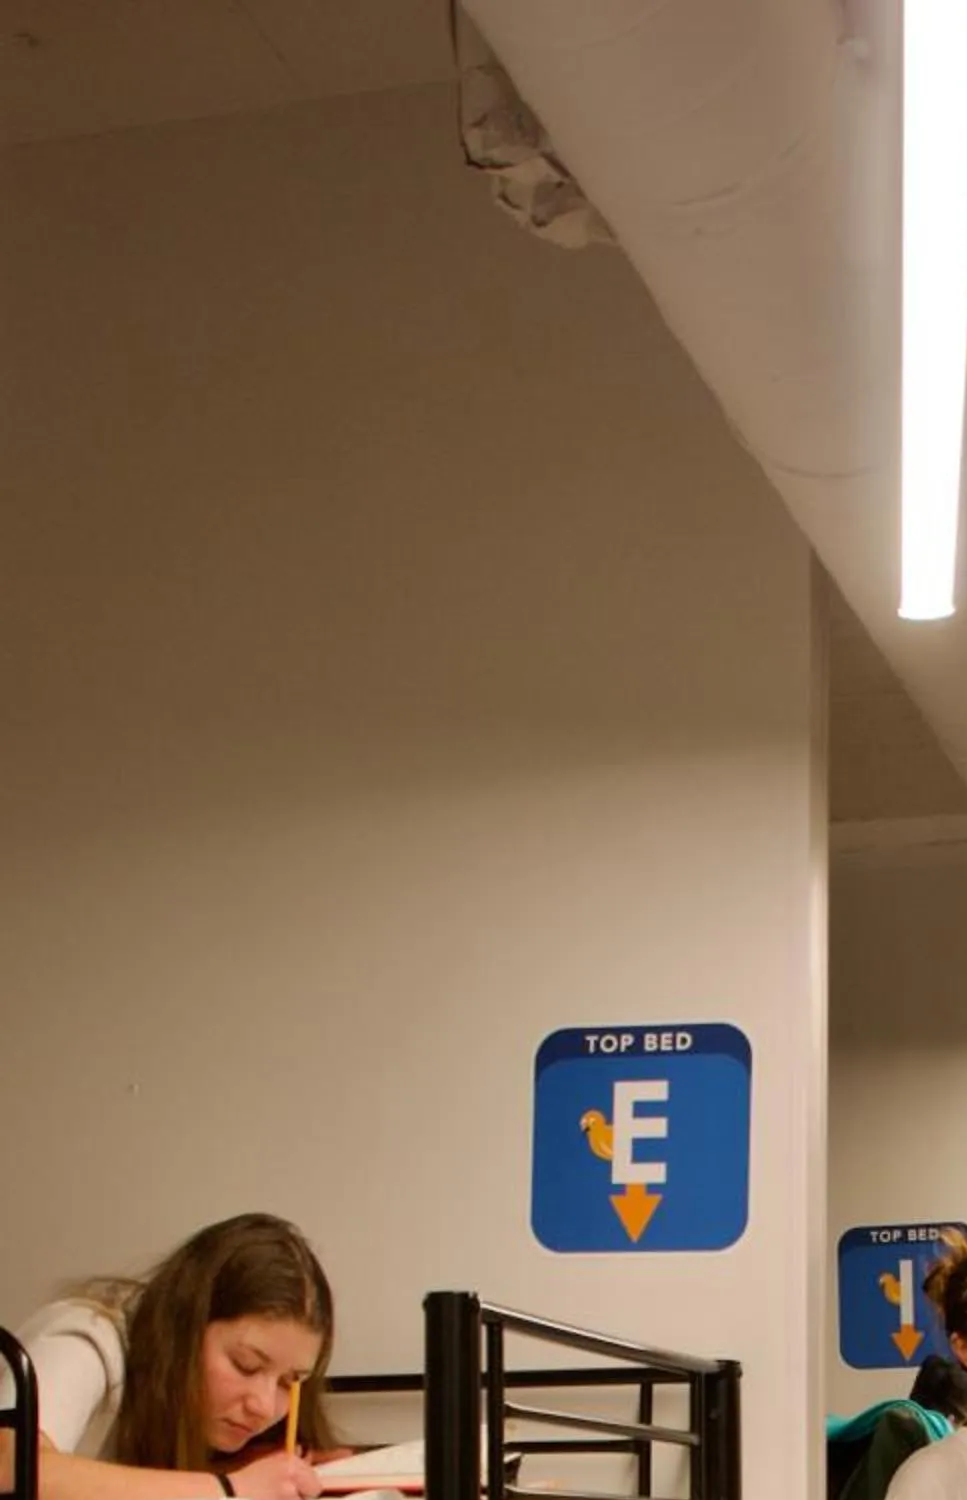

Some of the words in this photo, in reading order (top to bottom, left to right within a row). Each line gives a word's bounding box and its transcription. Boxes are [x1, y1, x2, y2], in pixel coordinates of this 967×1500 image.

[585, 1034, 635, 1054] TOP
[644, 1031, 692, 1051] BED
[612, 1079, 669, 1184] E
[870, 1229, 902, 1243] TOP
[907, 1227, 939, 1241] BED
